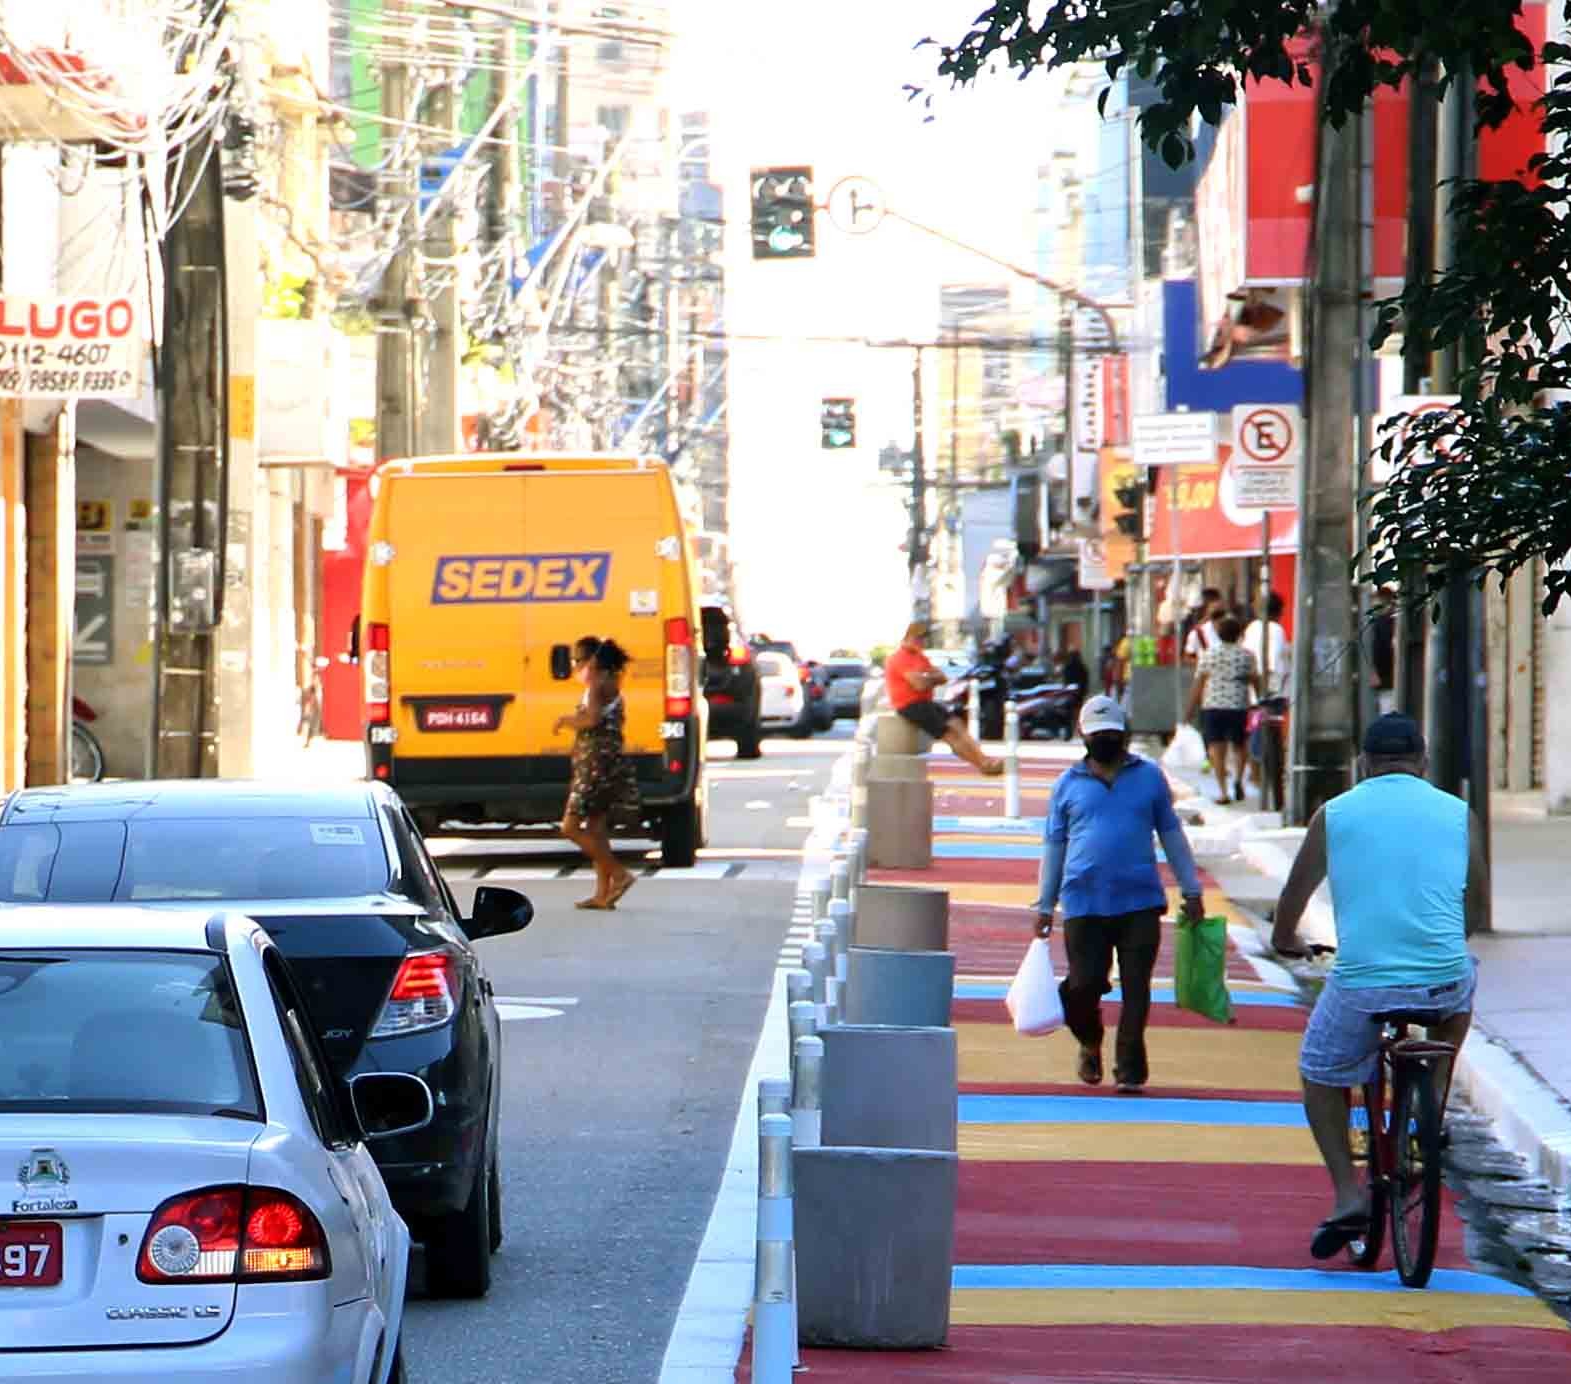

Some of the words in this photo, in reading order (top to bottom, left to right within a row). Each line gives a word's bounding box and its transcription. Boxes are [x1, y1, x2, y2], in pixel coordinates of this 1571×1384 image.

[438, 559, 602, 601] SEDEX
[12, 1199, 79, 1214] Fortaleza
[105, 1305, 188, 1320] CLASSIC
[193, 1305, 222, 1319] LS
